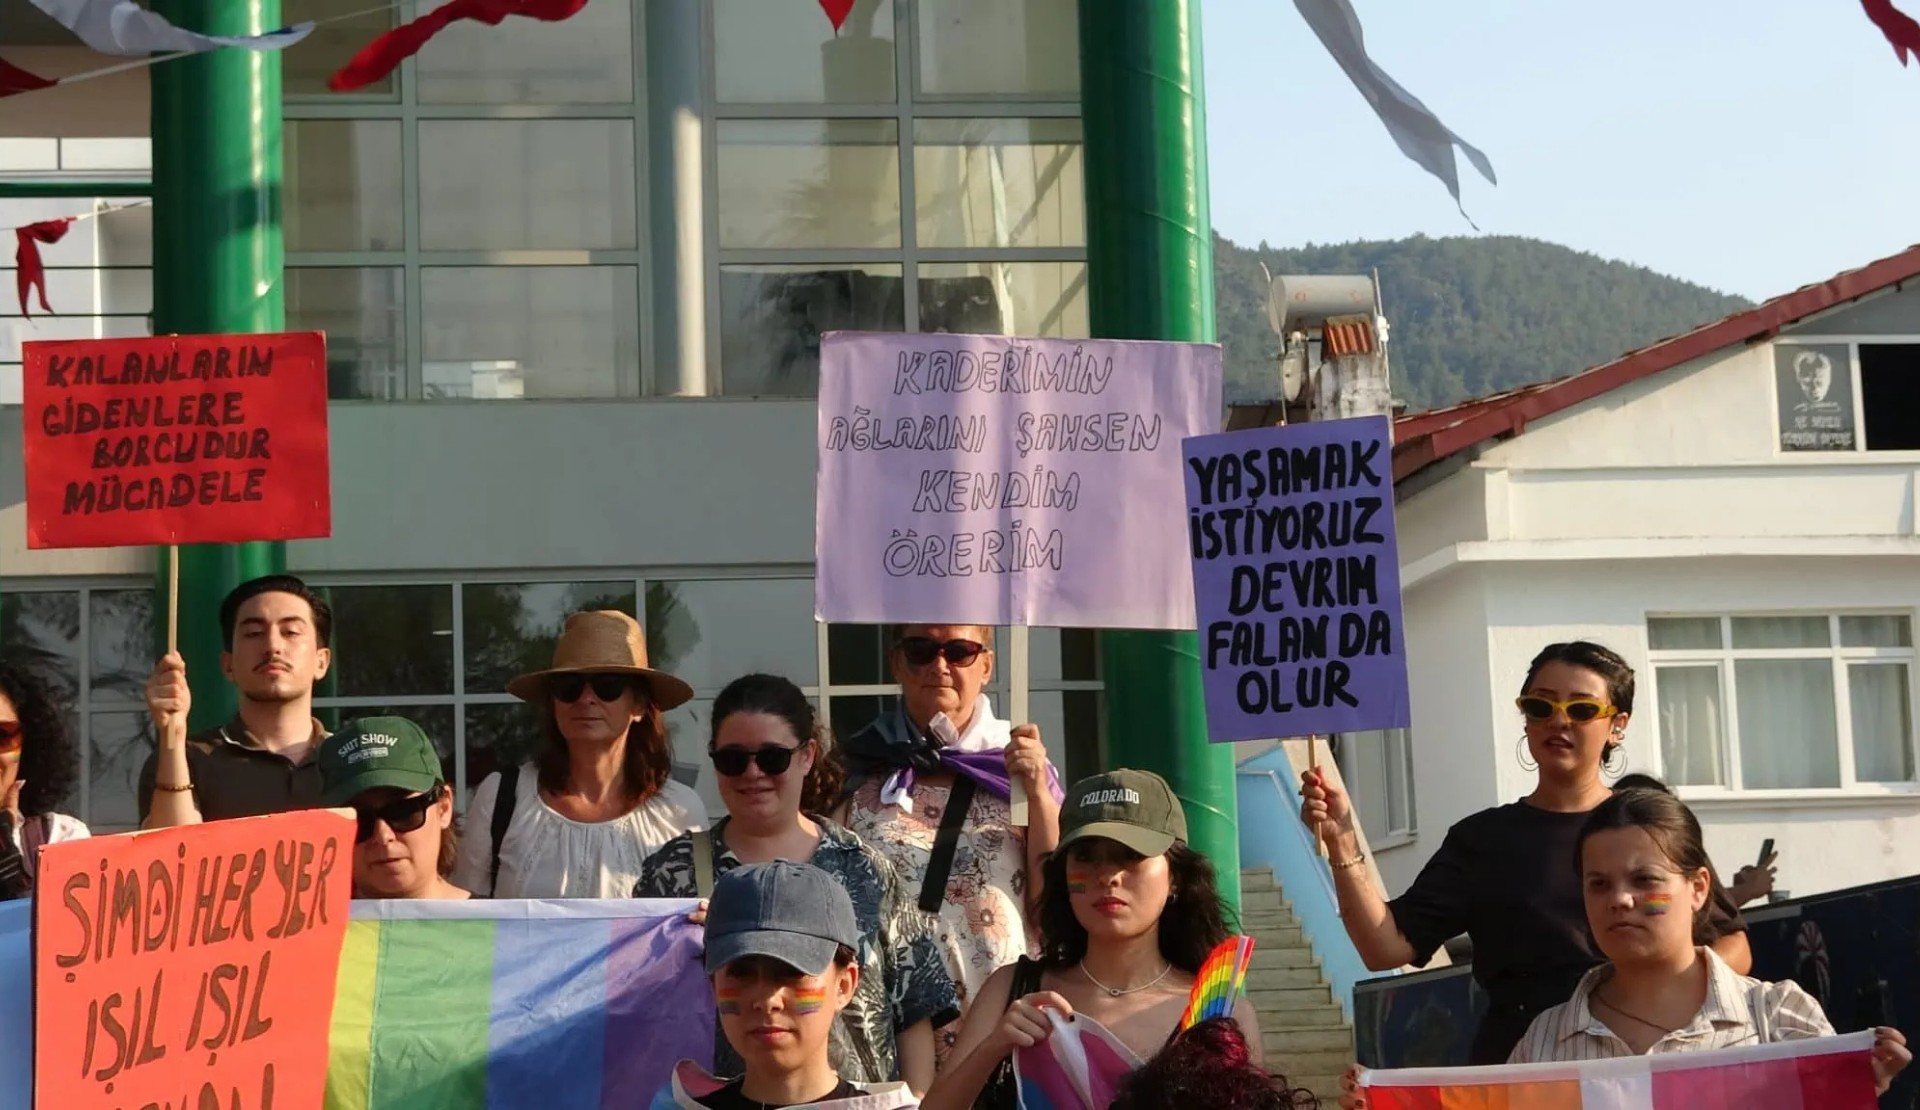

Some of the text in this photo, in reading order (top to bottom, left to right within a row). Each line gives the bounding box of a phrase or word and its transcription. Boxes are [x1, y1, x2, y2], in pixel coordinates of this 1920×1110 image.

[46, 346, 273, 387] KALANLARIN
[894, 345, 1113, 395] KADERİMİN
[42, 392, 244, 436] GİDENLERE
[826, 405, 1161, 458] AĞLARINI ŞAHSEN
[62, 468, 267, 515] MÜCADELE
[912, 464, 1081, 512] KENDİM
[1189, 439, 1381, 507] YAŞAMAK
[883, 520, 1063, 577] ÖRERİM
[1191, 497, 1385, 559] İSTİYORUZ
[1207, 610, 1391, 670] FALAN DA
[1236, 660, 1359, 715] OLUR
[361, 733, 398, 746] SHOW
[1080, 788, 1140, 807] COLORADO
[55, 836, 338, 983] ŞİMDİ HER YER
[82, 950, 273, 1094] IŞIL IŞIL
